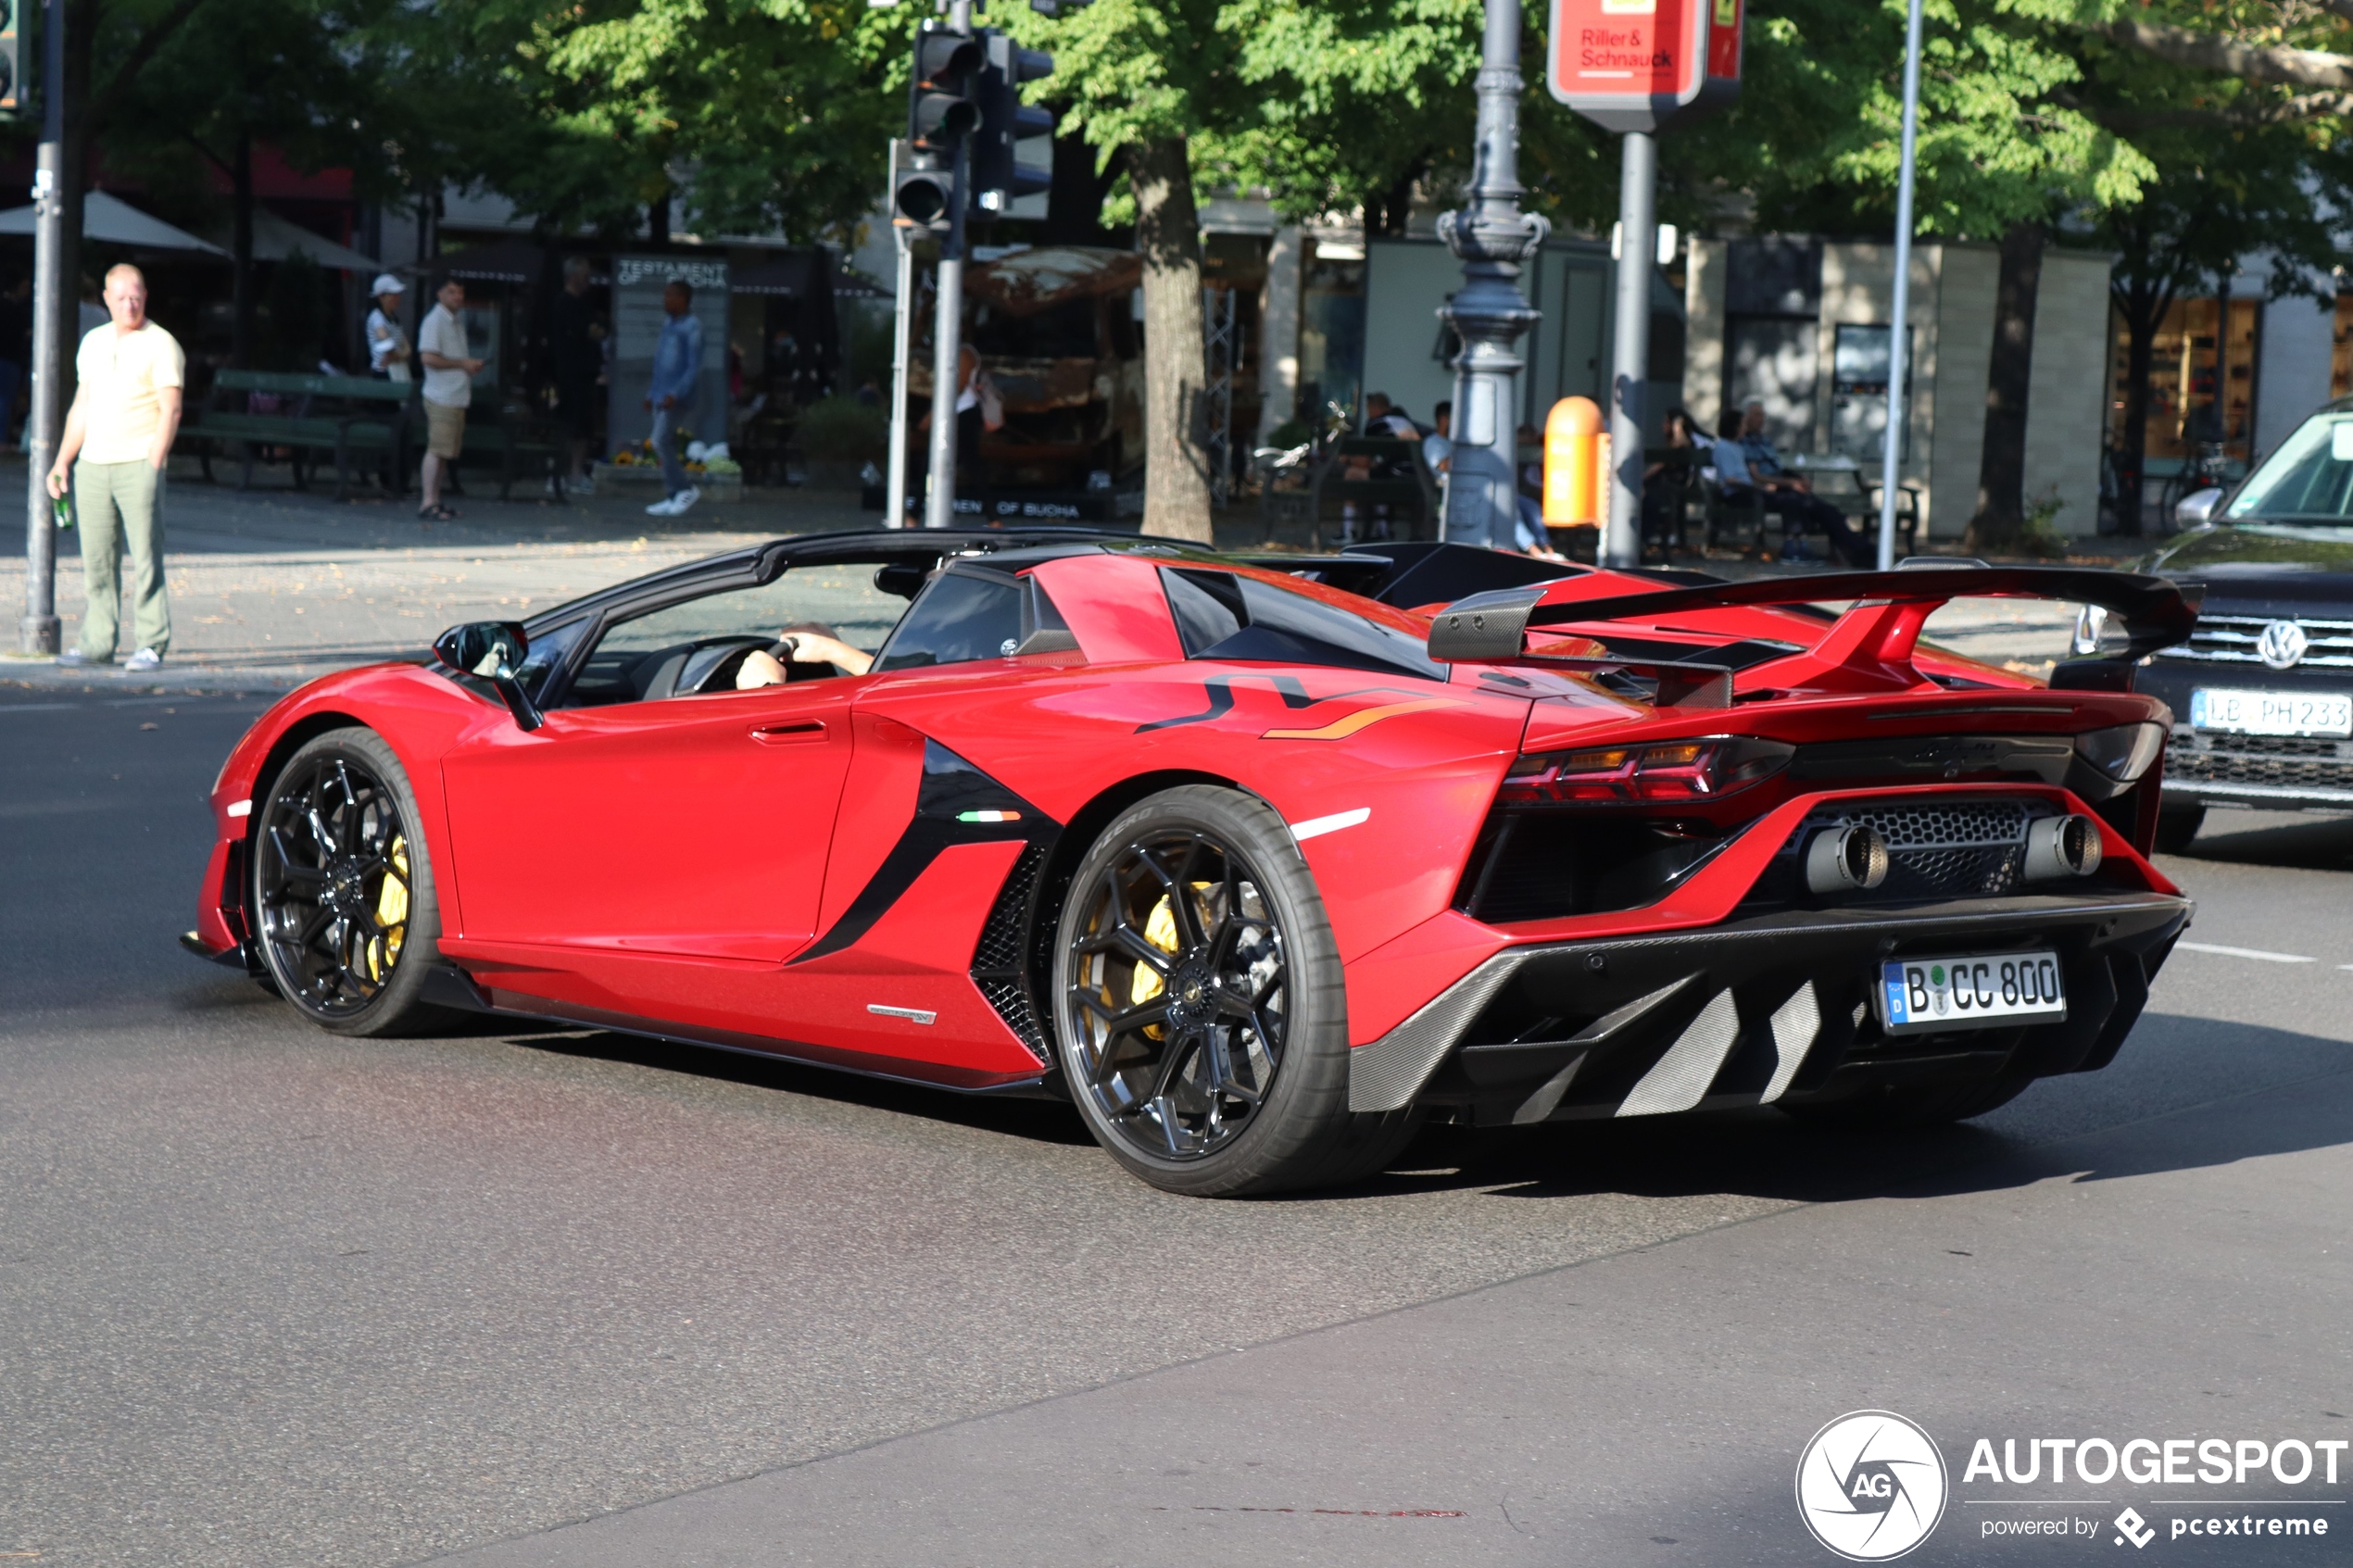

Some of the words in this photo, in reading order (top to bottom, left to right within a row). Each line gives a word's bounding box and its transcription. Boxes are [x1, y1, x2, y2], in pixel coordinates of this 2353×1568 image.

[1581, 29, 1626, 46] Riller
[1629, 29, 1641, 46] &
[1581, 49, 1672, 68] Schnauck
[619, 259, 728, 275] TESTAMENT
[997, 501, 1020, 515] OF
[1024, 503, 1079, 518] BUCHA
[2210, 697, 2241, 722] LB
[2262, 700, 2293, 724] PH
[2301, 702, 2347, 727] 233
[1906, 967, 1929, 1012] B
[1951, 963, 1993, 1010] CC
[2000, 960, 2057, 1006] 800
[1893, 998, 1903, 1013] D
